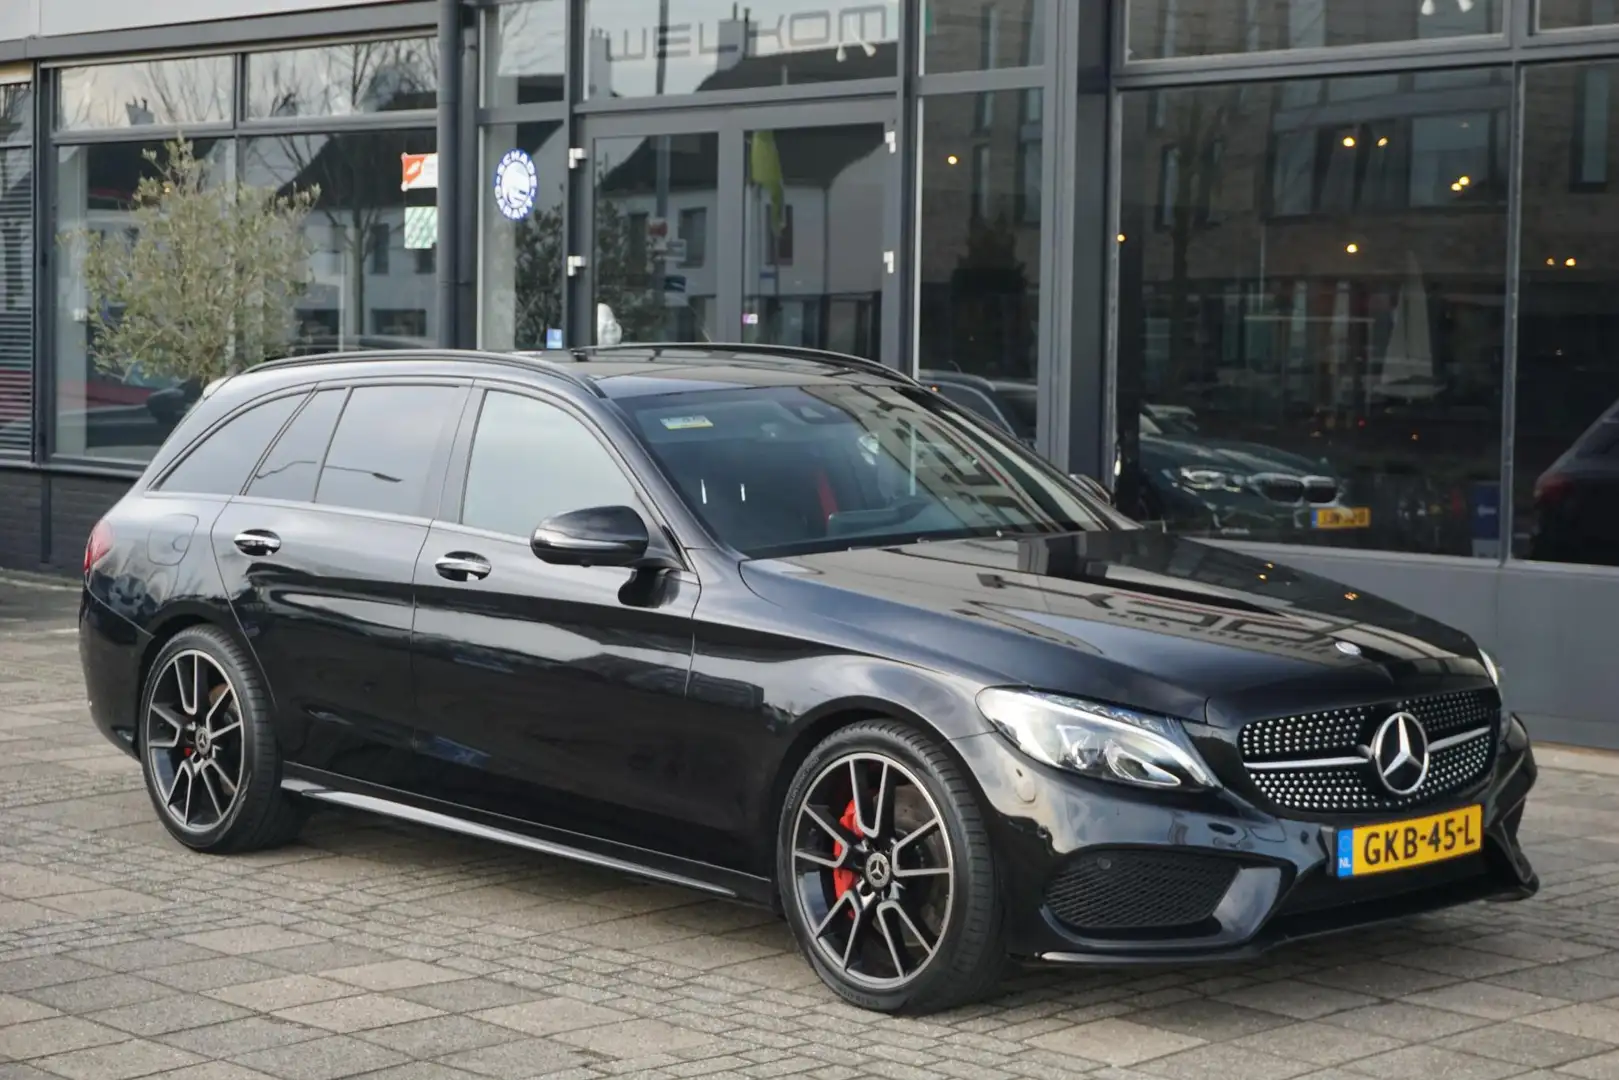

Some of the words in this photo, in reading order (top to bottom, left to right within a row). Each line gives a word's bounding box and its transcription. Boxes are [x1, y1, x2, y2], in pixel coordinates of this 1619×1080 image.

[606, 5, 888, 62] WELKOM
[1338, 857, 1351, 869] NL
[1363, 814, 1476, 866] GKB-45-L
